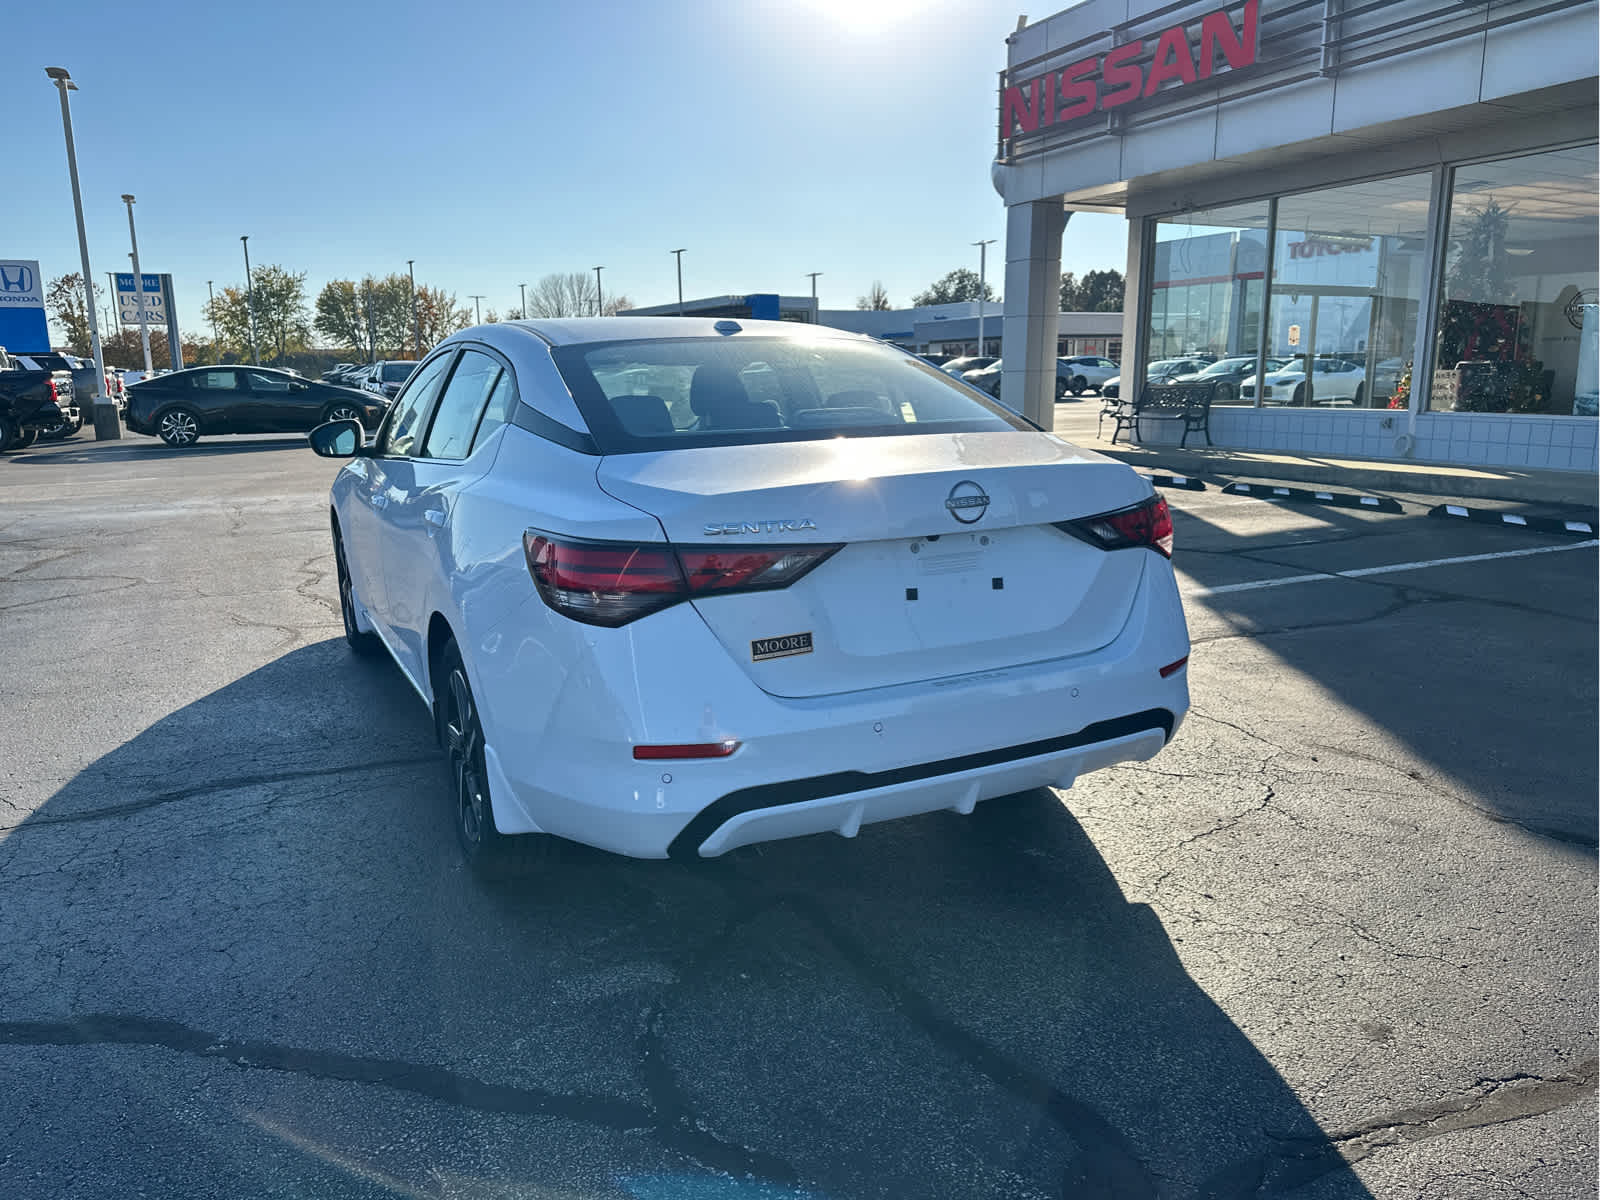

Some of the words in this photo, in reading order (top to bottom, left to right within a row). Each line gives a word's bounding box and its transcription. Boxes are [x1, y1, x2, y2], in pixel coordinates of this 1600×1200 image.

[1003, 0, 1258, 138] NISSAN
[703, 519, 817, 536] SENTRA
[756, 636, 808, 653] MOORE
